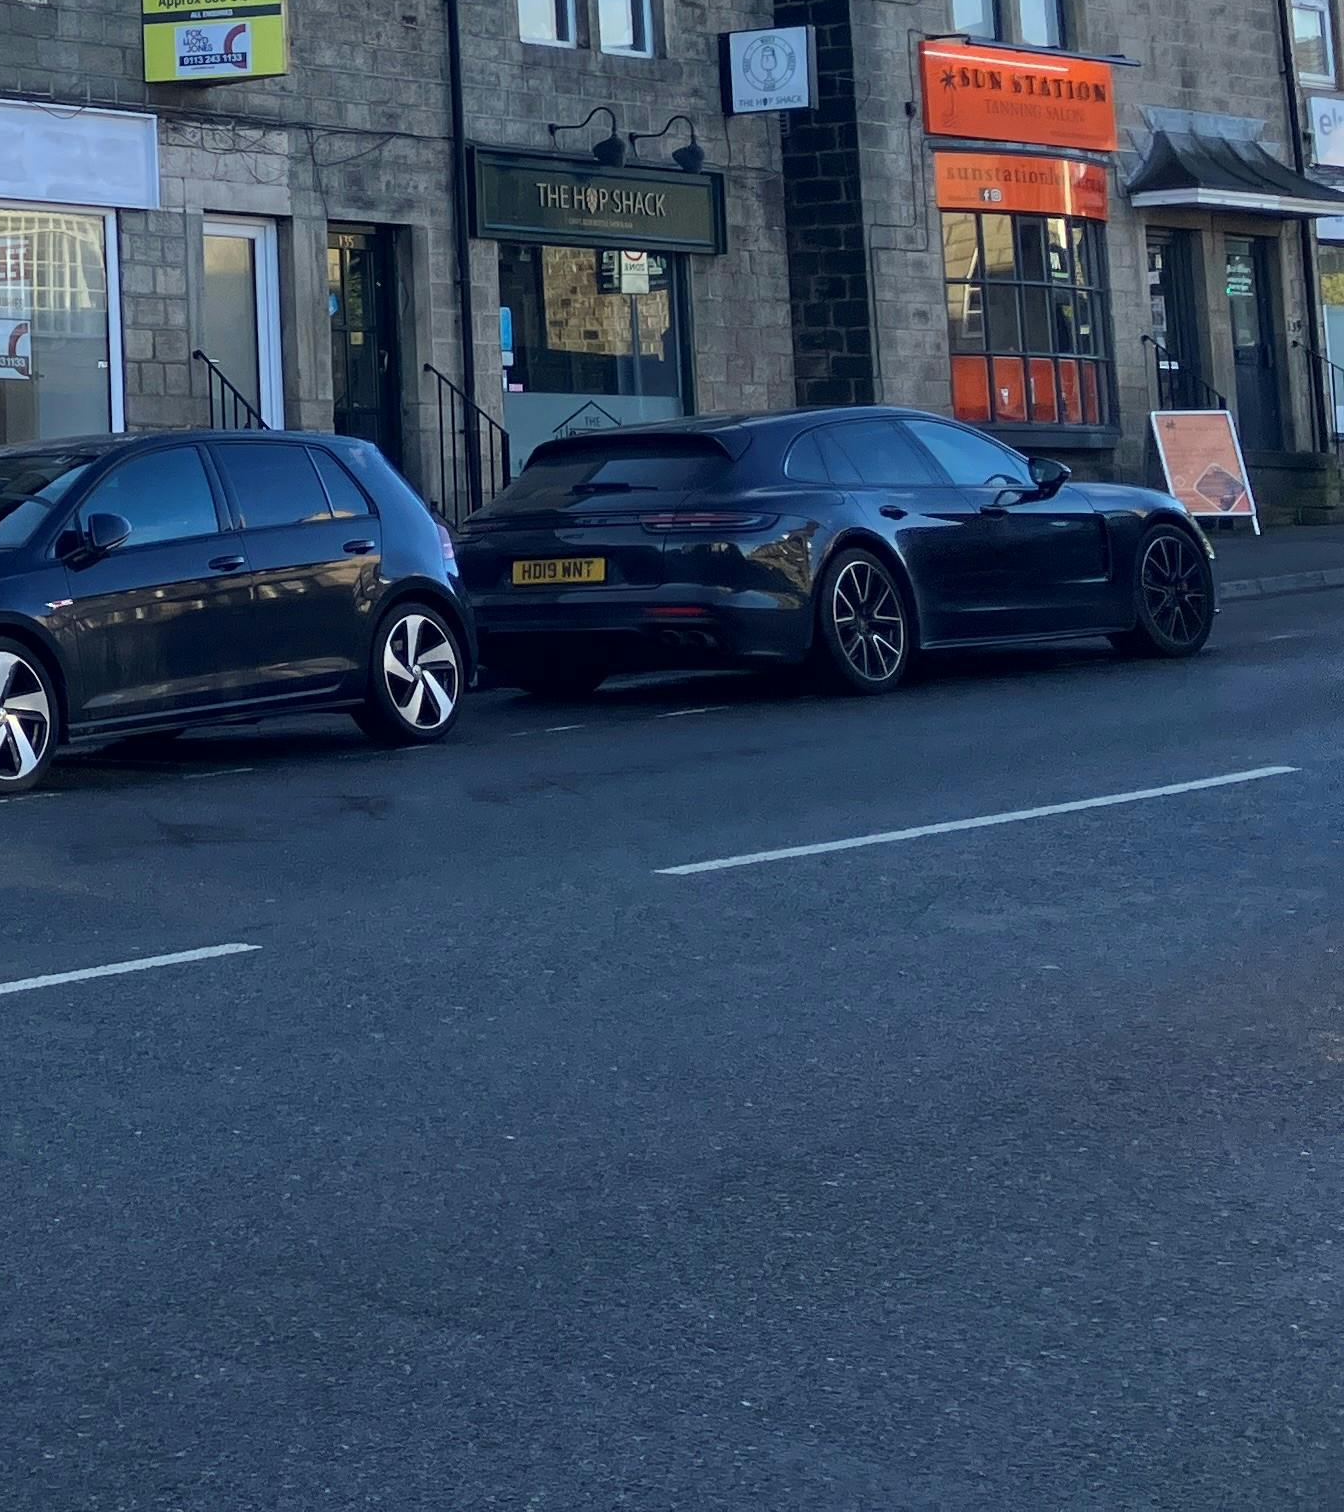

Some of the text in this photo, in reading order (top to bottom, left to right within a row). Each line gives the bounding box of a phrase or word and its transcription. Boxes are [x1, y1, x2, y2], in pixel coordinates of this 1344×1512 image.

[185, 29, 202, 37] FOX
[183, 37, 209, 46] LLOYD
[187, 44, 213, 53] JONES
[183, 53, 243, 65] 0113 243 1133
[958, 67, 1107, 103] SUN STATION
[984, 98, 1041, 120] TANNING
[536, 182, 570, 209] THE
[613, 189, 666, 217] SHACK
[6, 358, 26, 368] 1133
[584, 416, 601, 428] THE
[521, 560, 594, 581] HD19 WNT
